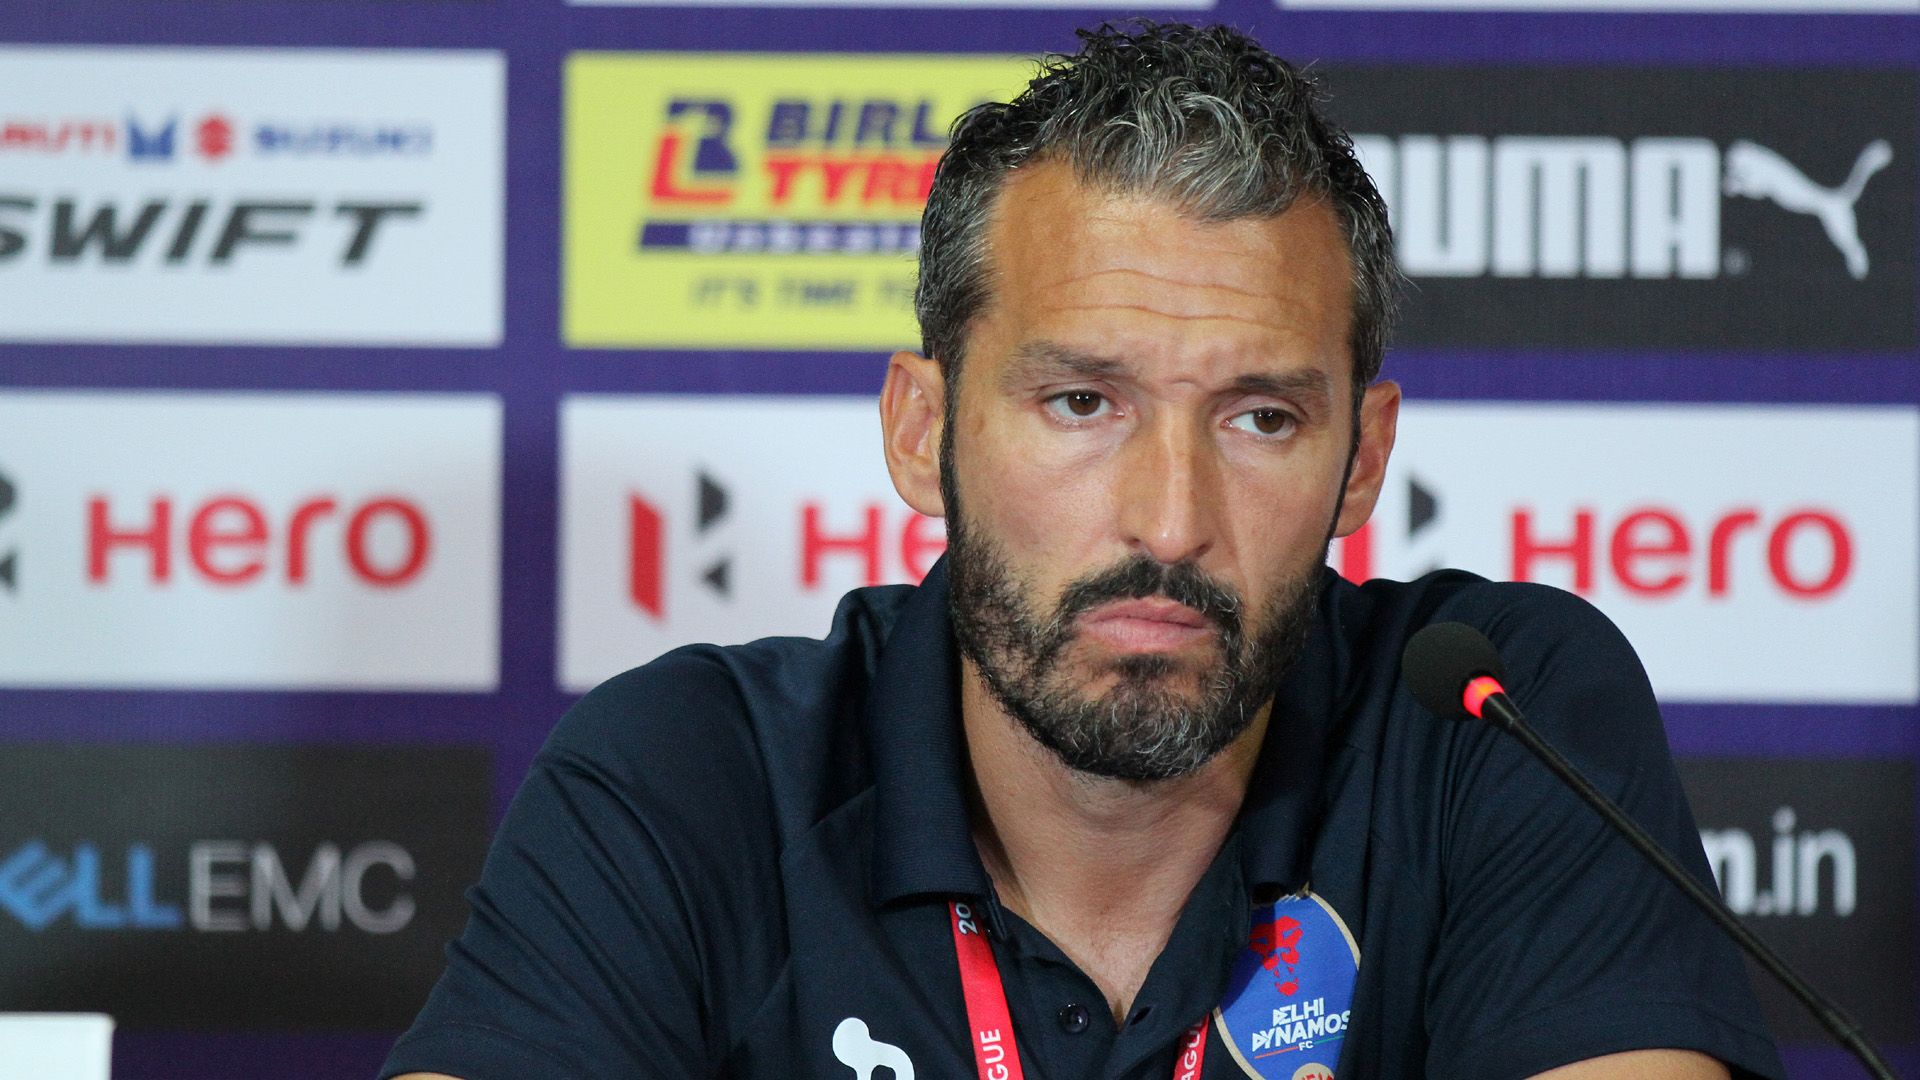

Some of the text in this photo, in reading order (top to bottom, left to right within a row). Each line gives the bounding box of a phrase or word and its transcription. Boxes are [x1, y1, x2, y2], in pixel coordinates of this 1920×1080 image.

[766, 97, 952, 145] BIRL
[85, 492, 433, 587] Hero
[1509, 507, 1854, 600] Hero
[190, 839, 416, 934] EMC
[1252, 1009, 1351, 1052] DYNAMOS
[1273, 997, 1325, 1027] DELHI
[1298, 1039, 1314, 1051] FC
